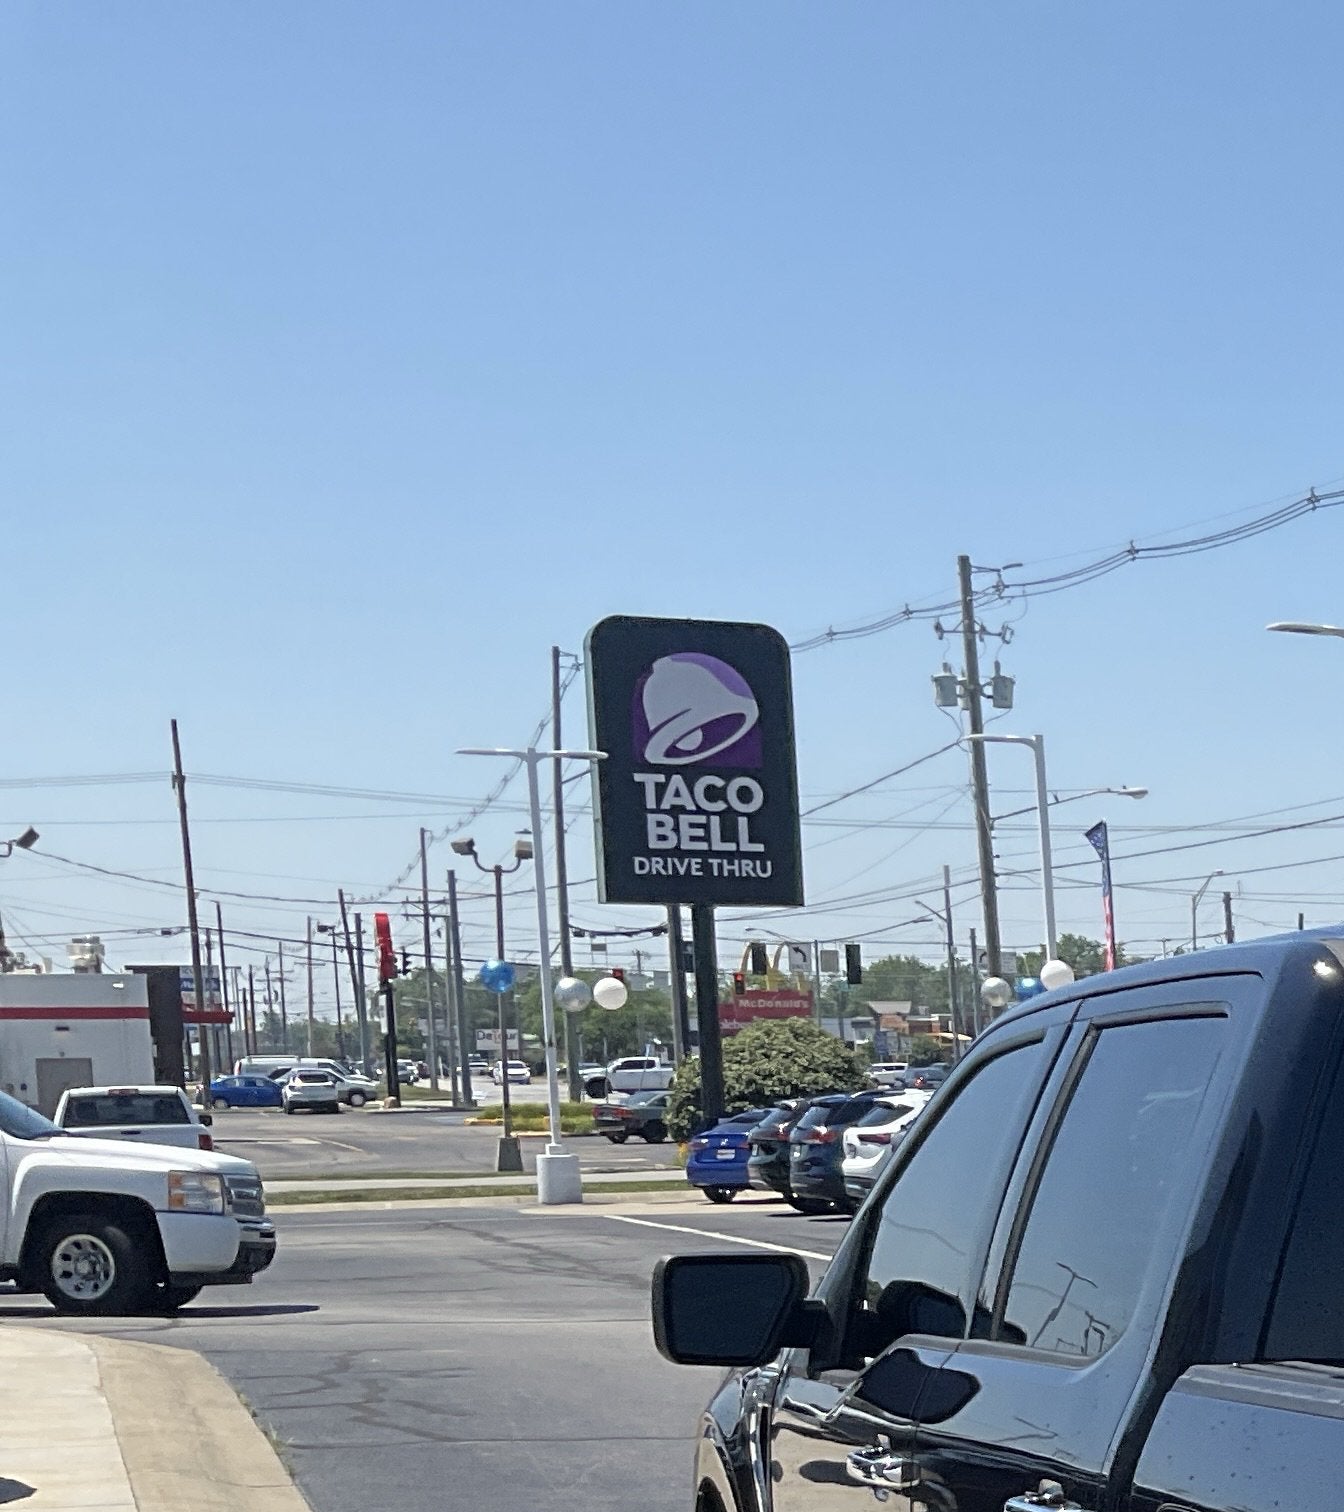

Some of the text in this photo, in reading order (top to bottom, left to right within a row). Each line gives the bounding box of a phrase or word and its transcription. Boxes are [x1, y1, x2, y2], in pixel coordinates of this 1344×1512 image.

[632, 772, 764, 814] TACO
[646, 813, 765, 853] BELL
[632, 856, 773, 879] DRIVE THRU
[738, 999, 809, 1009] McDonald's
